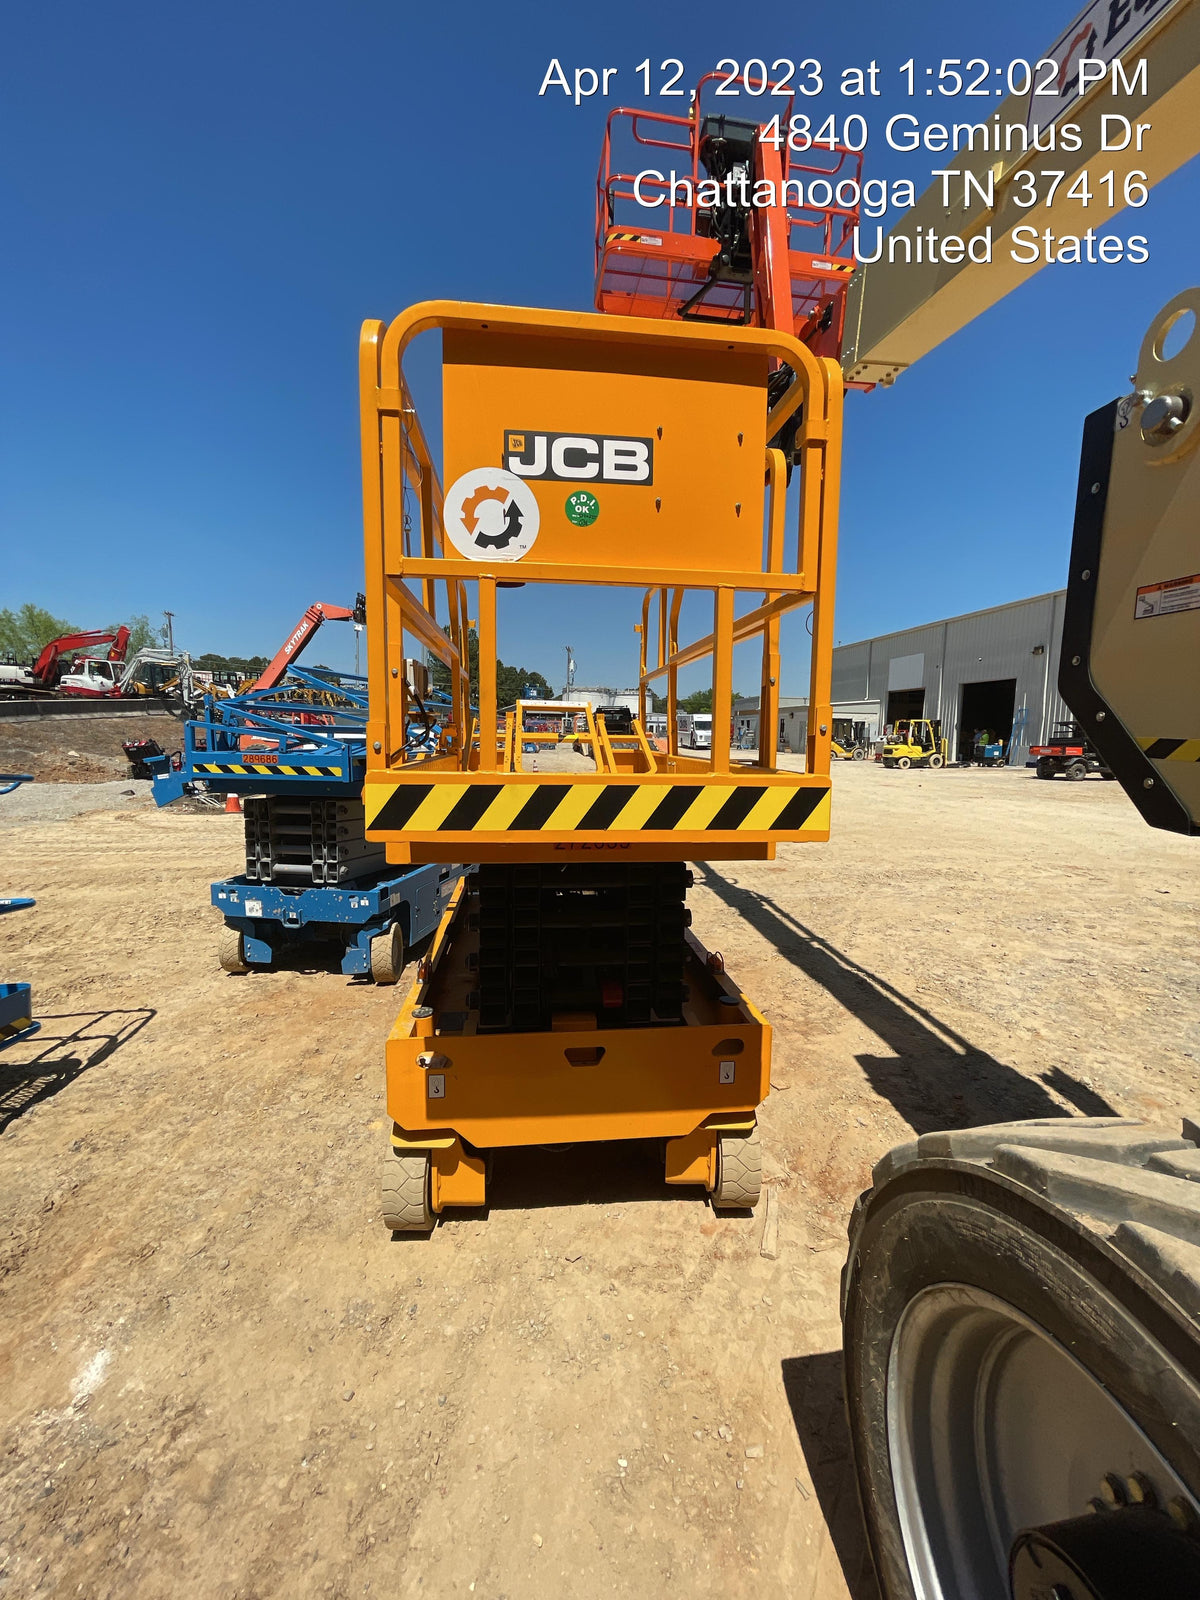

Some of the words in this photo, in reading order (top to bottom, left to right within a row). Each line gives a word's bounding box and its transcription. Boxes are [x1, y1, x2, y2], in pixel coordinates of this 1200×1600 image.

[508, 436, 650, 481] JCB
[575, 505, 590, 514] OK
[284, 620, 309, 655] SKYTRAK
[242, 754, 278, 764] 289686
